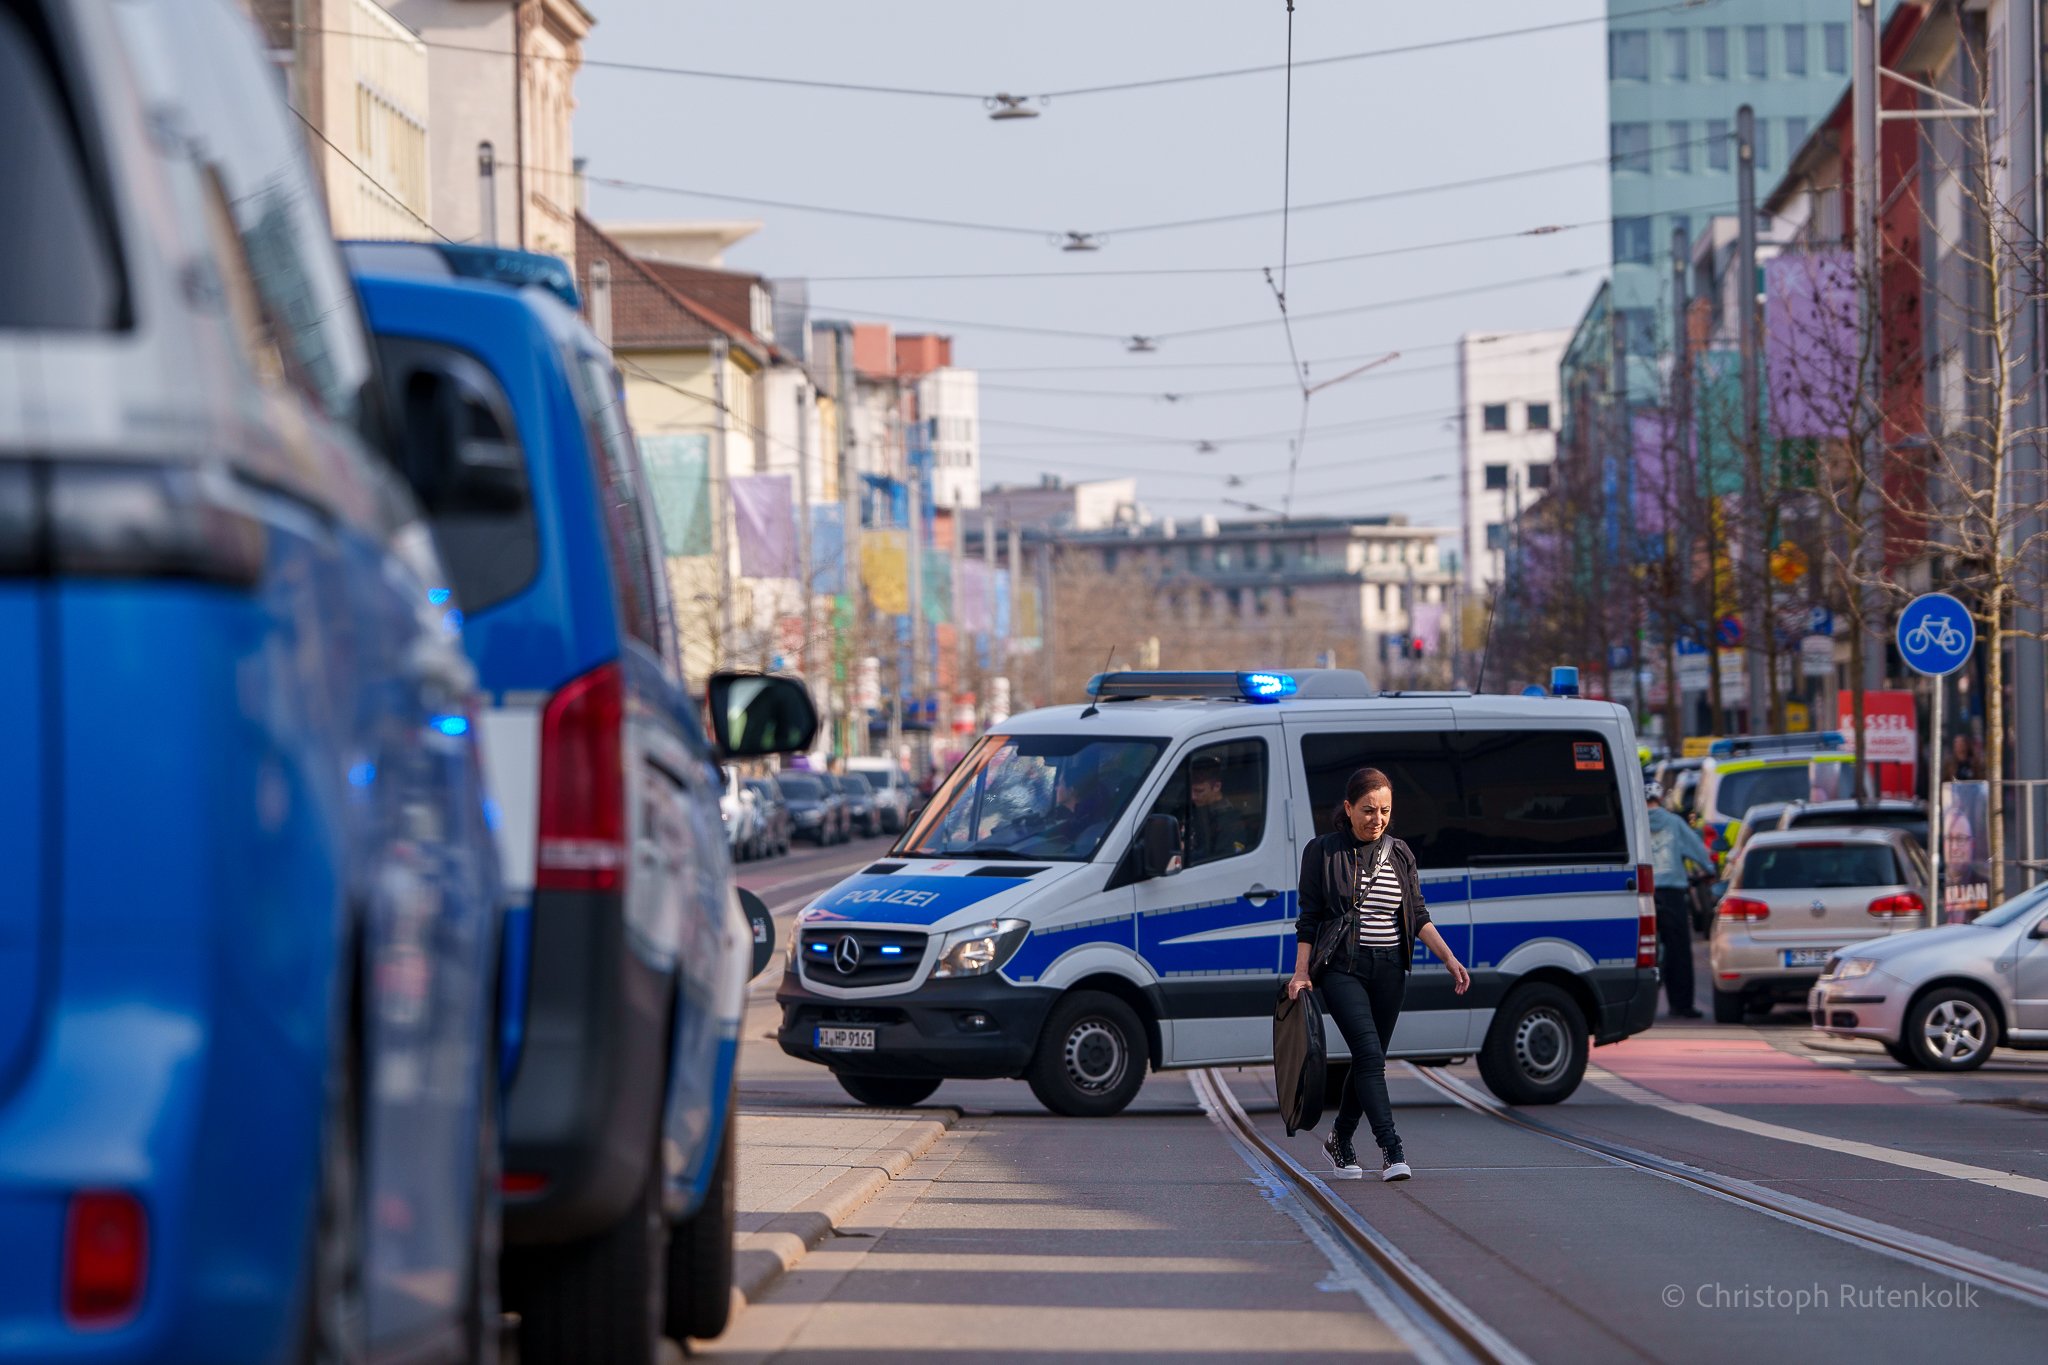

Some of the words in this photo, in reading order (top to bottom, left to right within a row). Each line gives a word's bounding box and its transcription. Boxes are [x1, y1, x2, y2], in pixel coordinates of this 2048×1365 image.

[1841, 714, 1909, 730] KSSEL
[835, 889, 940, 907] POLIZEI
[835, 1031, 847, 1046] HP
[848, 1031, 873, 1047] 9161
